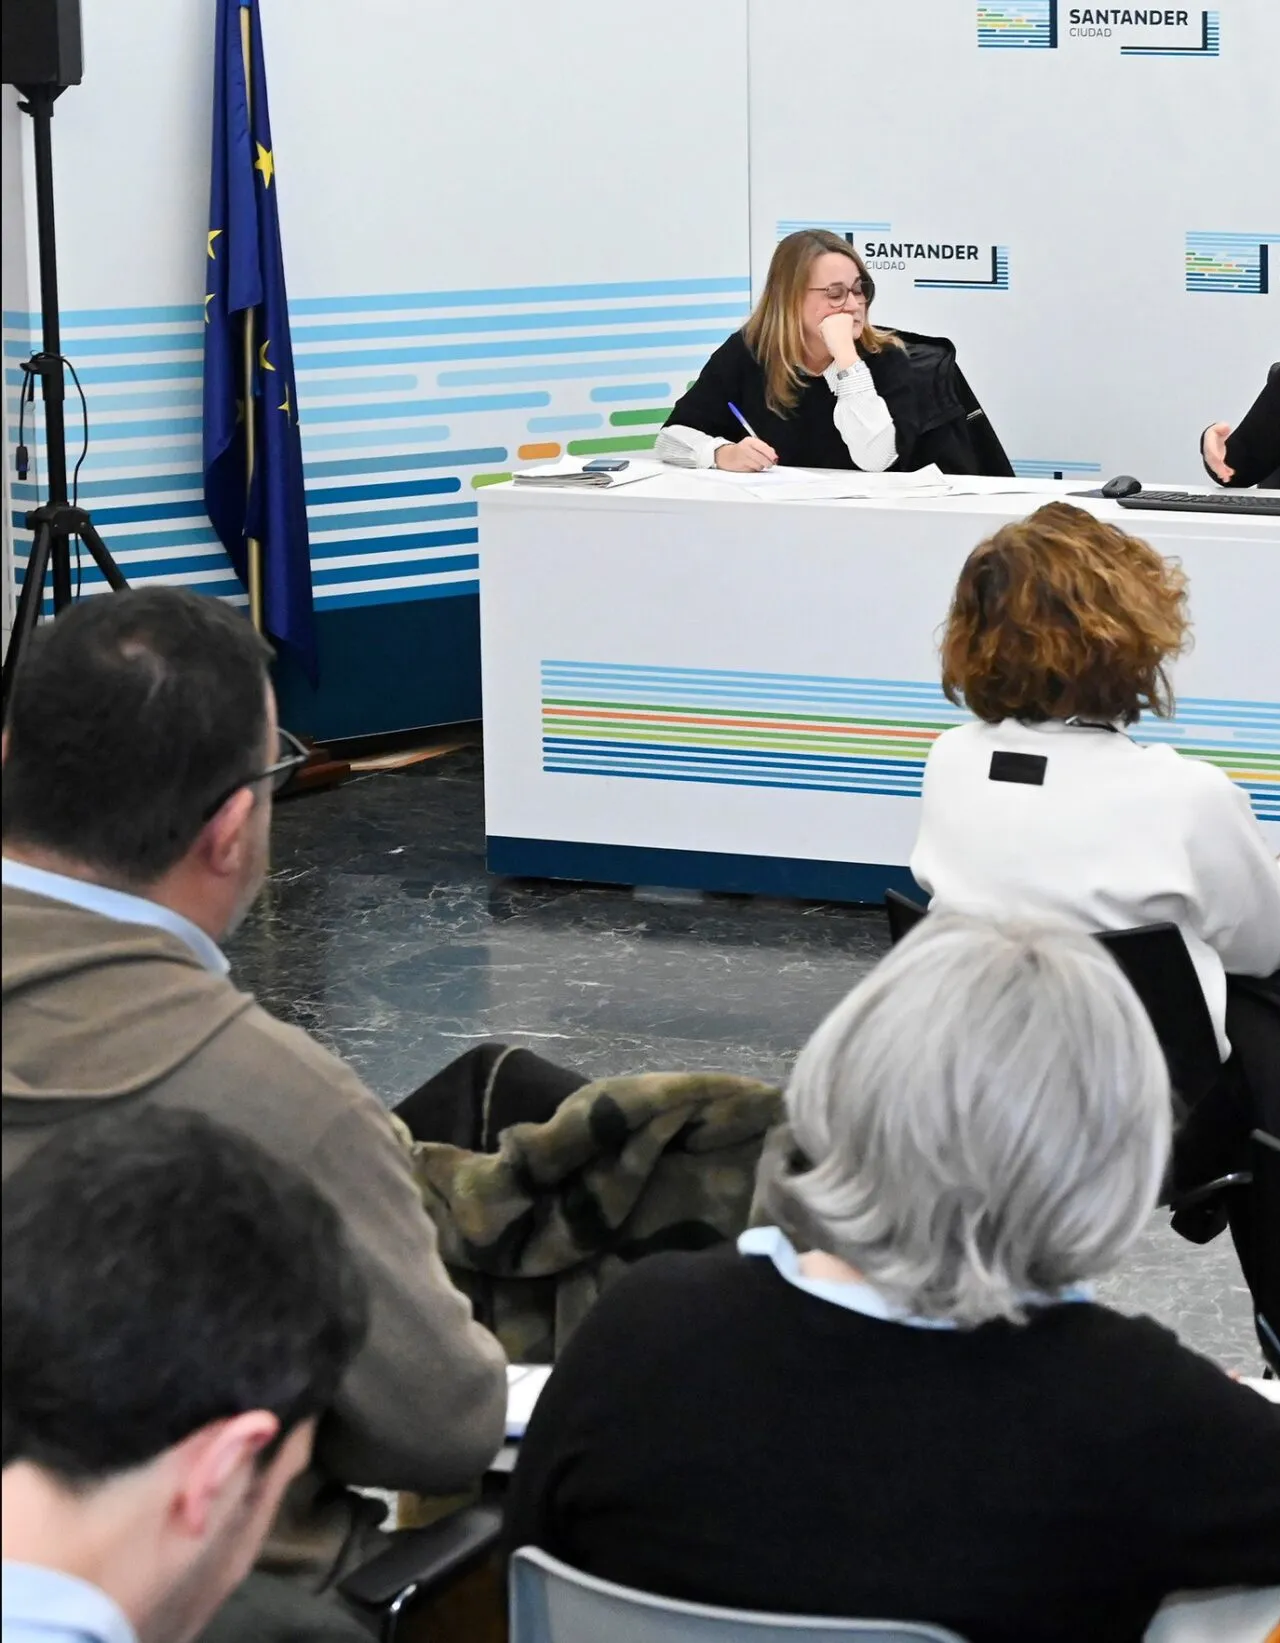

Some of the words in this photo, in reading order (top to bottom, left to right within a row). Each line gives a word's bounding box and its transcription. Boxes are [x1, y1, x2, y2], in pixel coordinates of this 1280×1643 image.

[1069, 9, 1188, 26] SANTANDER
[1069, 28, 1112, 38] CIUDAD
[865, 243, 979, 260] SANTANDER
[865, 260, 906, 271] CIUDAD
